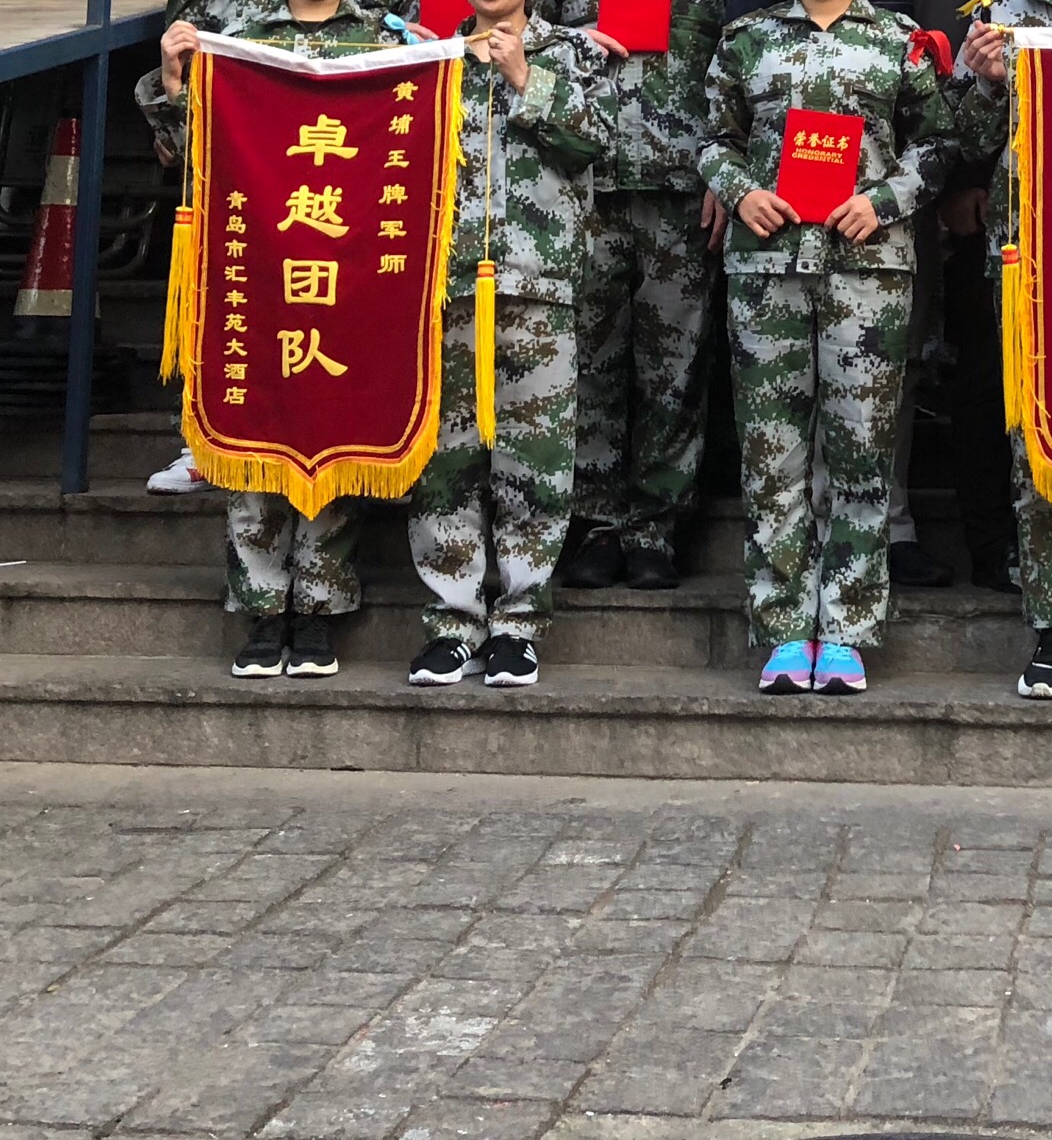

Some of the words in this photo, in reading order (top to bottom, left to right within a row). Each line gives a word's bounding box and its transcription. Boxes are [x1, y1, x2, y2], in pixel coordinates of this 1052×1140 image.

[377, 81, 419, 275] 黄埔王牌军师
[793, 130, 850, 151] 荣誉证书
[795, 147, 843, 159] HONORARY
[223, 190, 248, 406] 青岛市汇丰苑大酒店
[277, 114, 359, 378] 卓越团队
